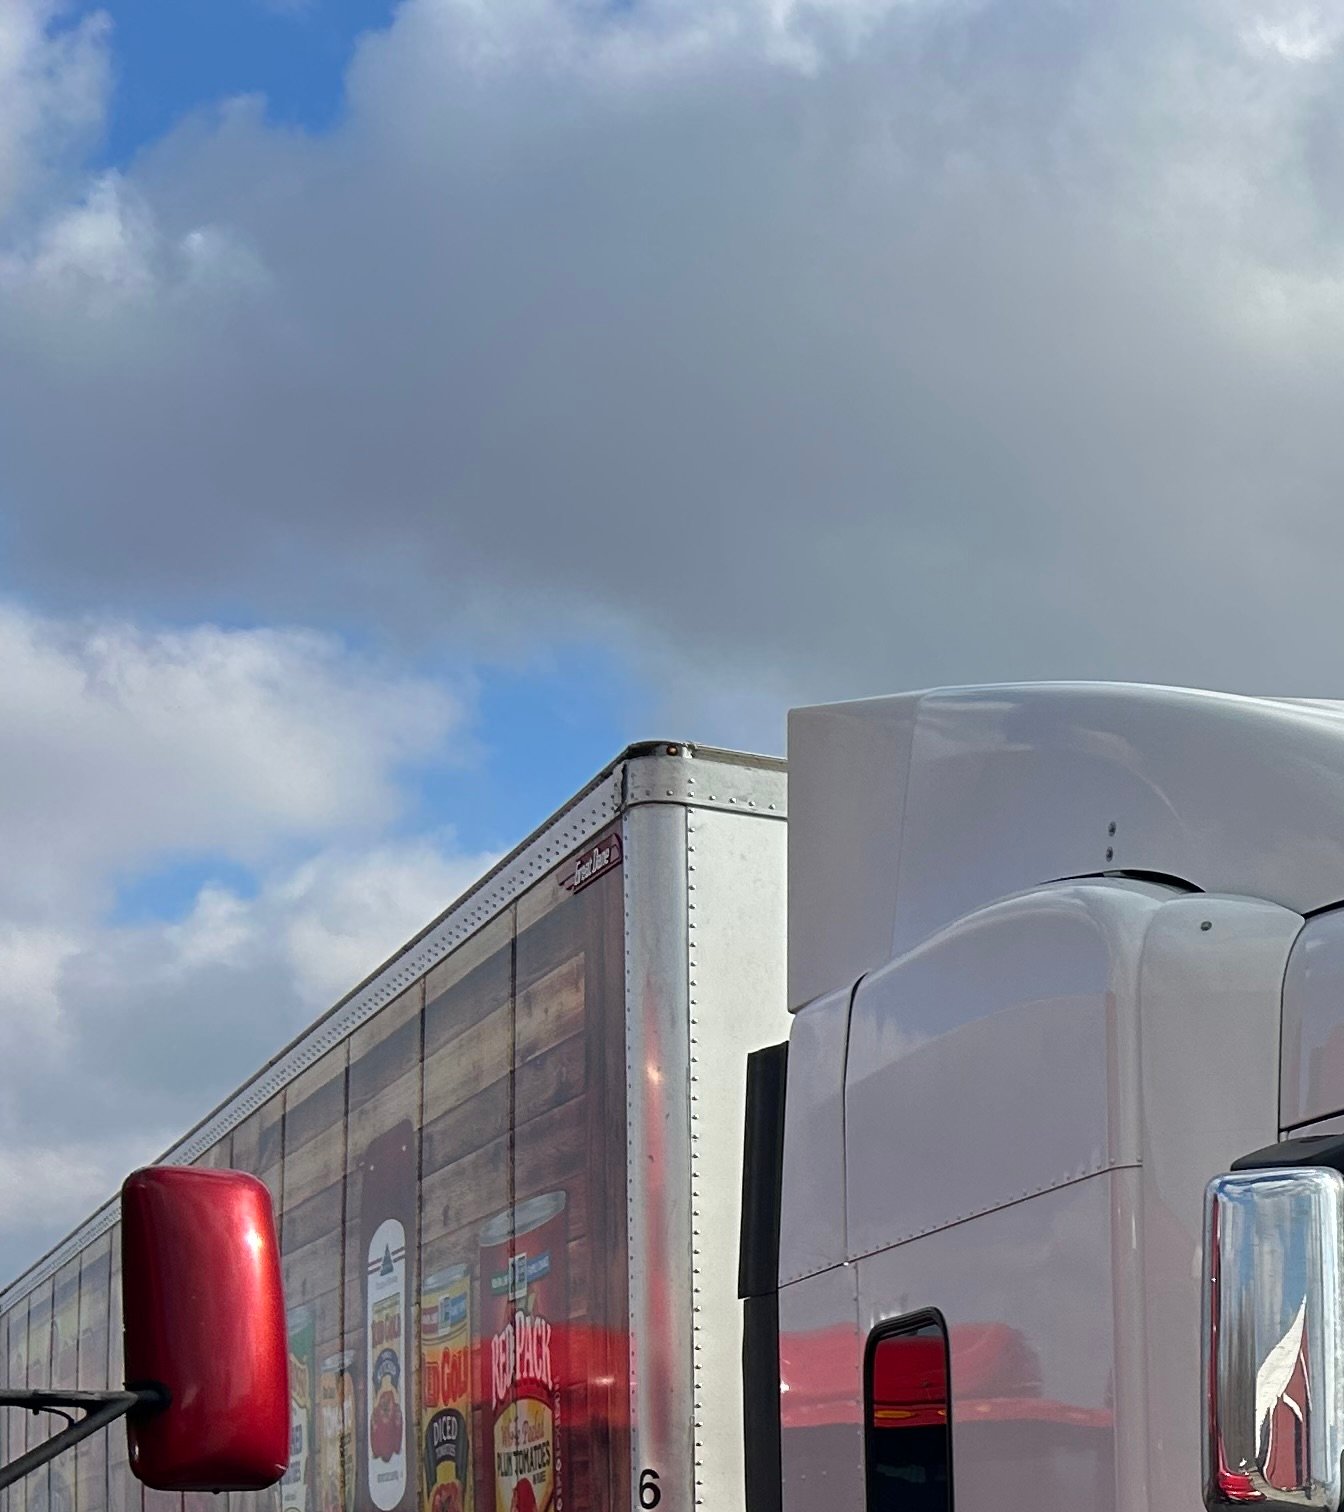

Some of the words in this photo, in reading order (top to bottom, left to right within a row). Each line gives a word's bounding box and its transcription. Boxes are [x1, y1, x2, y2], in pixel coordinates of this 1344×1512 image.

[491, 1322, 515, 1410] RED
[515, 1310, 553, 1390] PACK
[433, 1416, 458, 1446] DICED
[513, 1440, 551, 1475] TOMATOES
